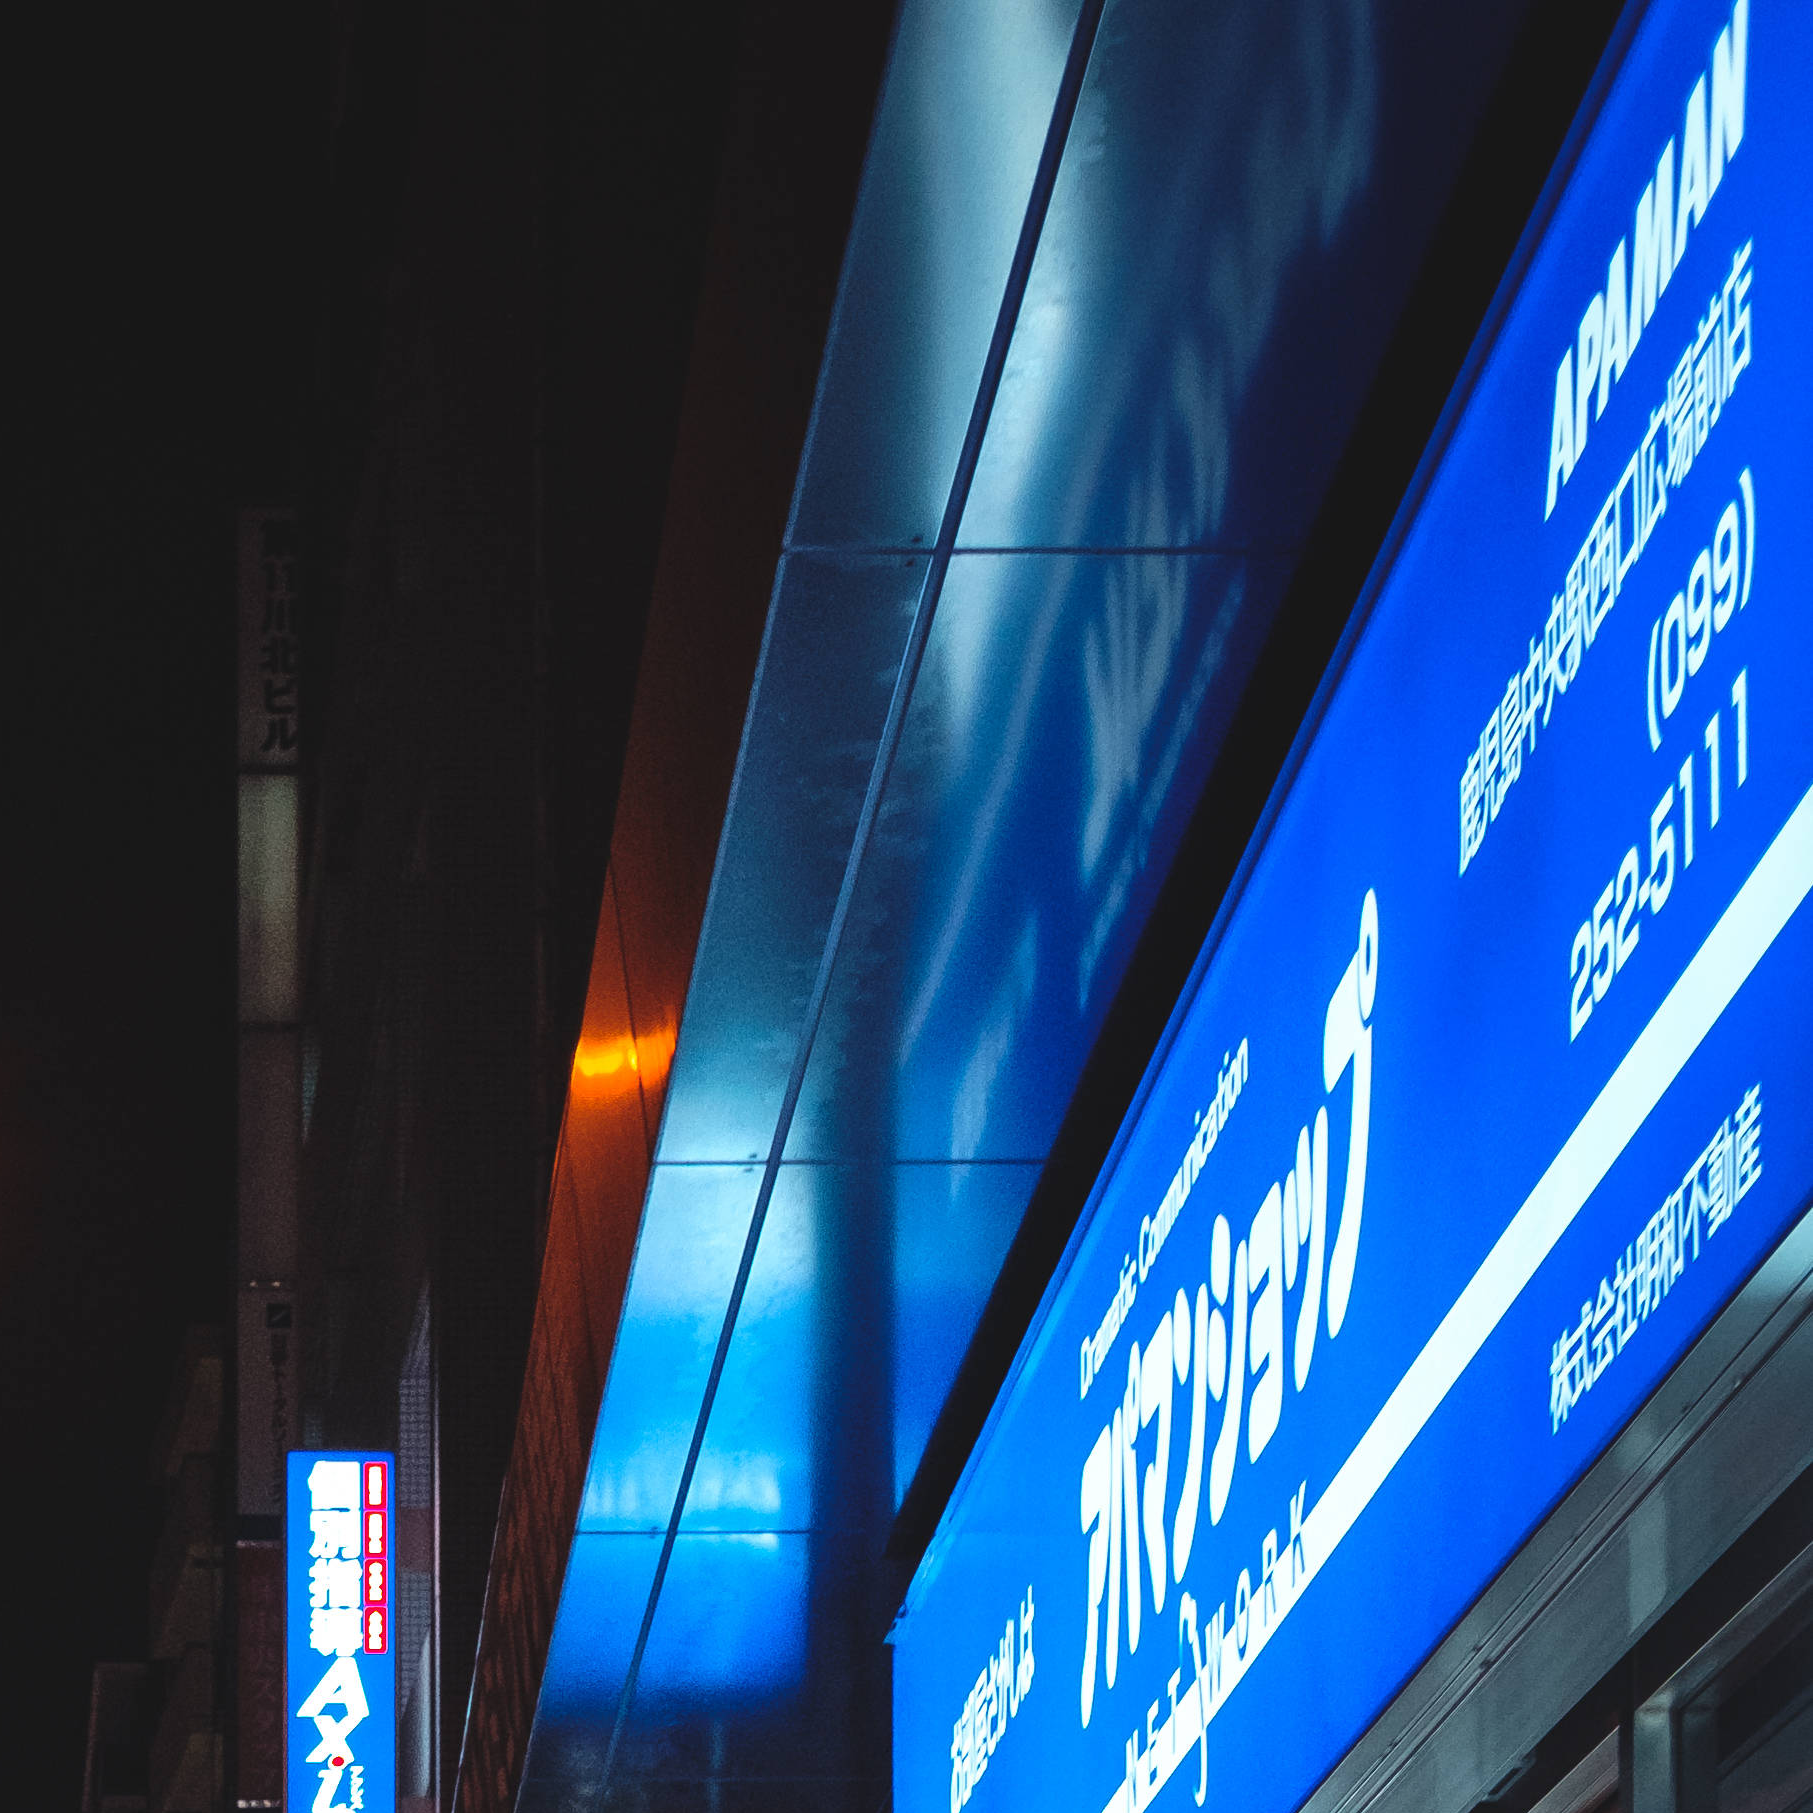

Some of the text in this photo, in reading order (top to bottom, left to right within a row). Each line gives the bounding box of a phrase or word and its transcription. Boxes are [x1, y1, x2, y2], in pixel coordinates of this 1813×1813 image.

[1544, 0, 1748, 522] APAMAN
[1458, 236, 1754, 877] 鹿児島中央駅西口広場前店
[1646, 468, 1756, 751] (099)
[1569, 674, 1748, 1043] 252-5111
[1079, 1036, 1250, 1399] Dramatic Communication
[1080, 888, 1379, 1729] アパマンショップ
[1548, 1081, 1763, 1436] 株式会社明和不動産
